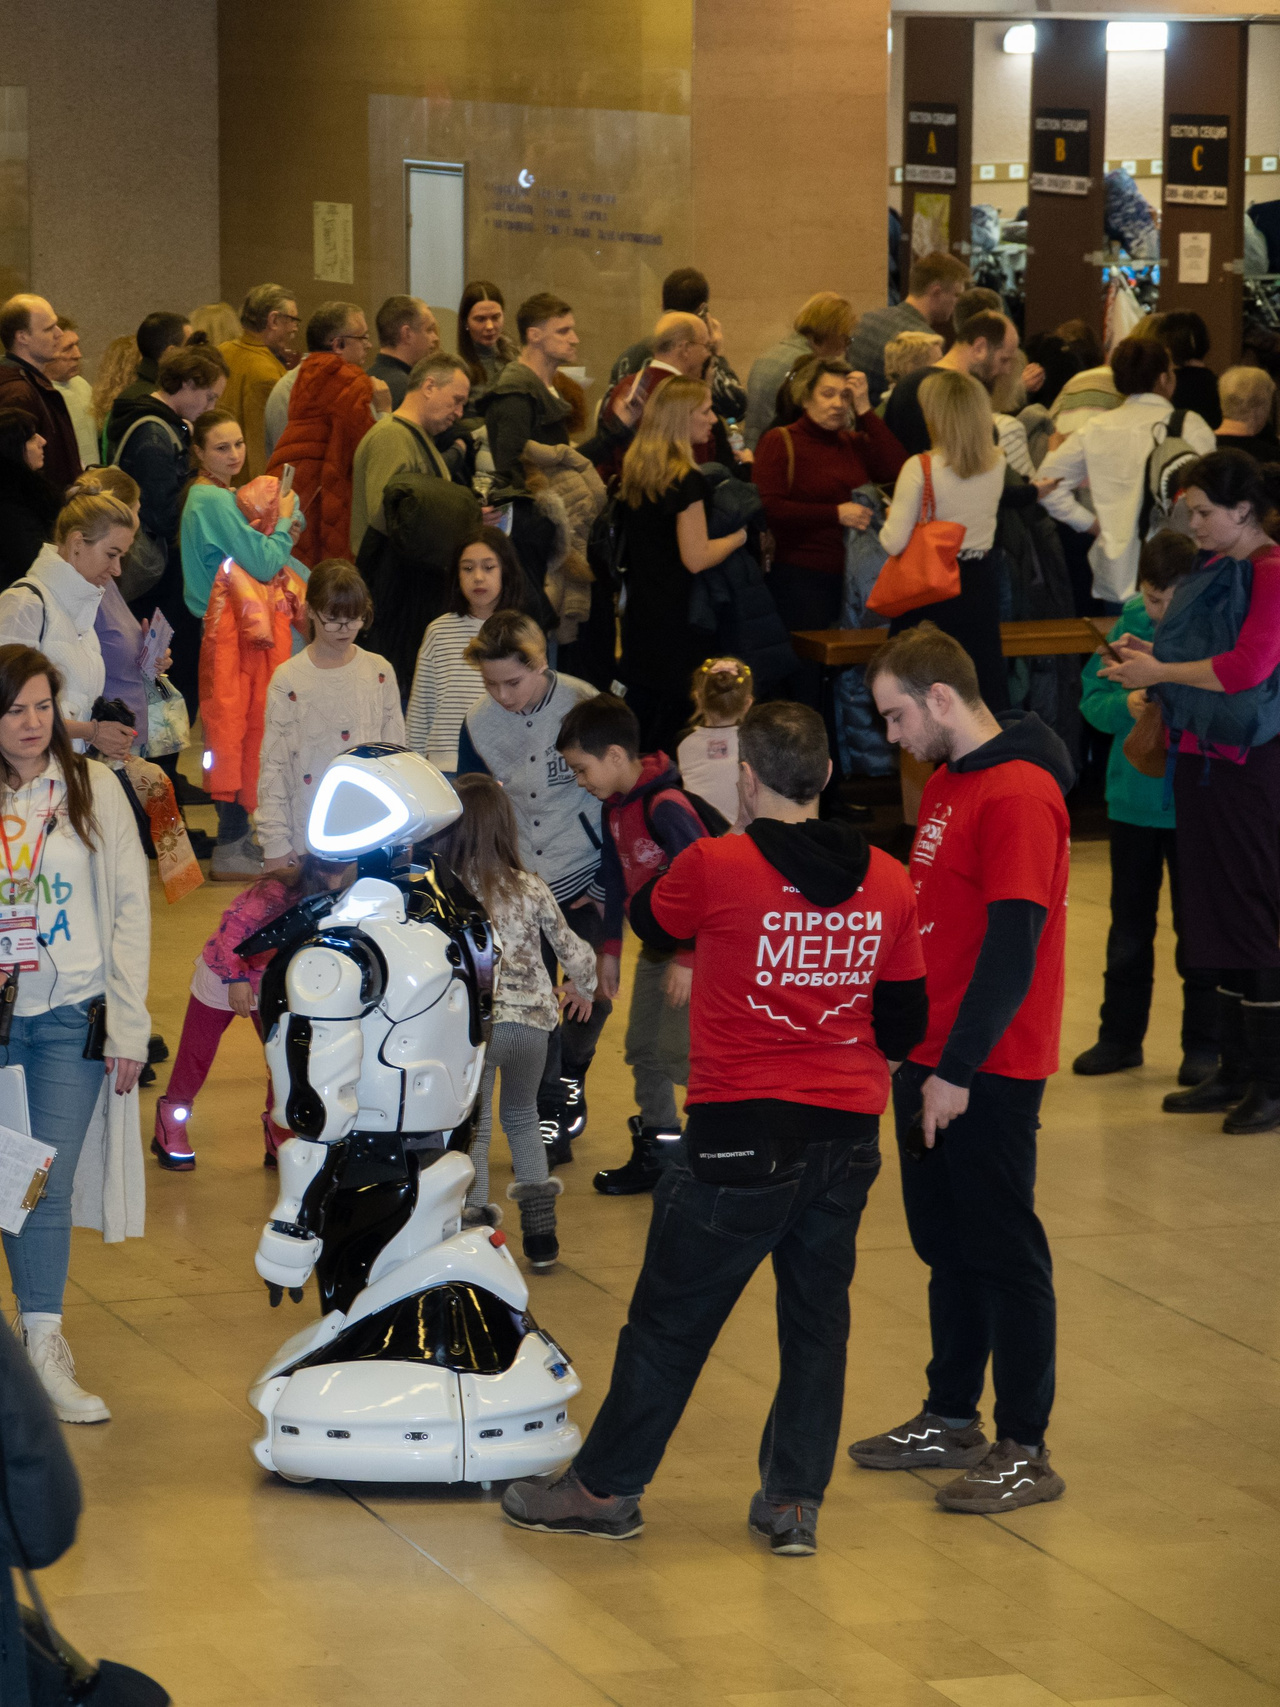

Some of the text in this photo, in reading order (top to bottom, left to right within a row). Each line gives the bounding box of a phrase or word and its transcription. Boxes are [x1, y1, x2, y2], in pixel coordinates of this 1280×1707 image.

[927, 130, 937, 154] A
[1055, 137, 1066, 162] B
[1192, 145, 1204, 171] C
[546, 756, 569, 778] BO
[762, 911, 882, 931] СПРОСИ
[756, 935, 881, 969] МЕНЯ
[756, 970, 873, 986] О РОБОТАХ
